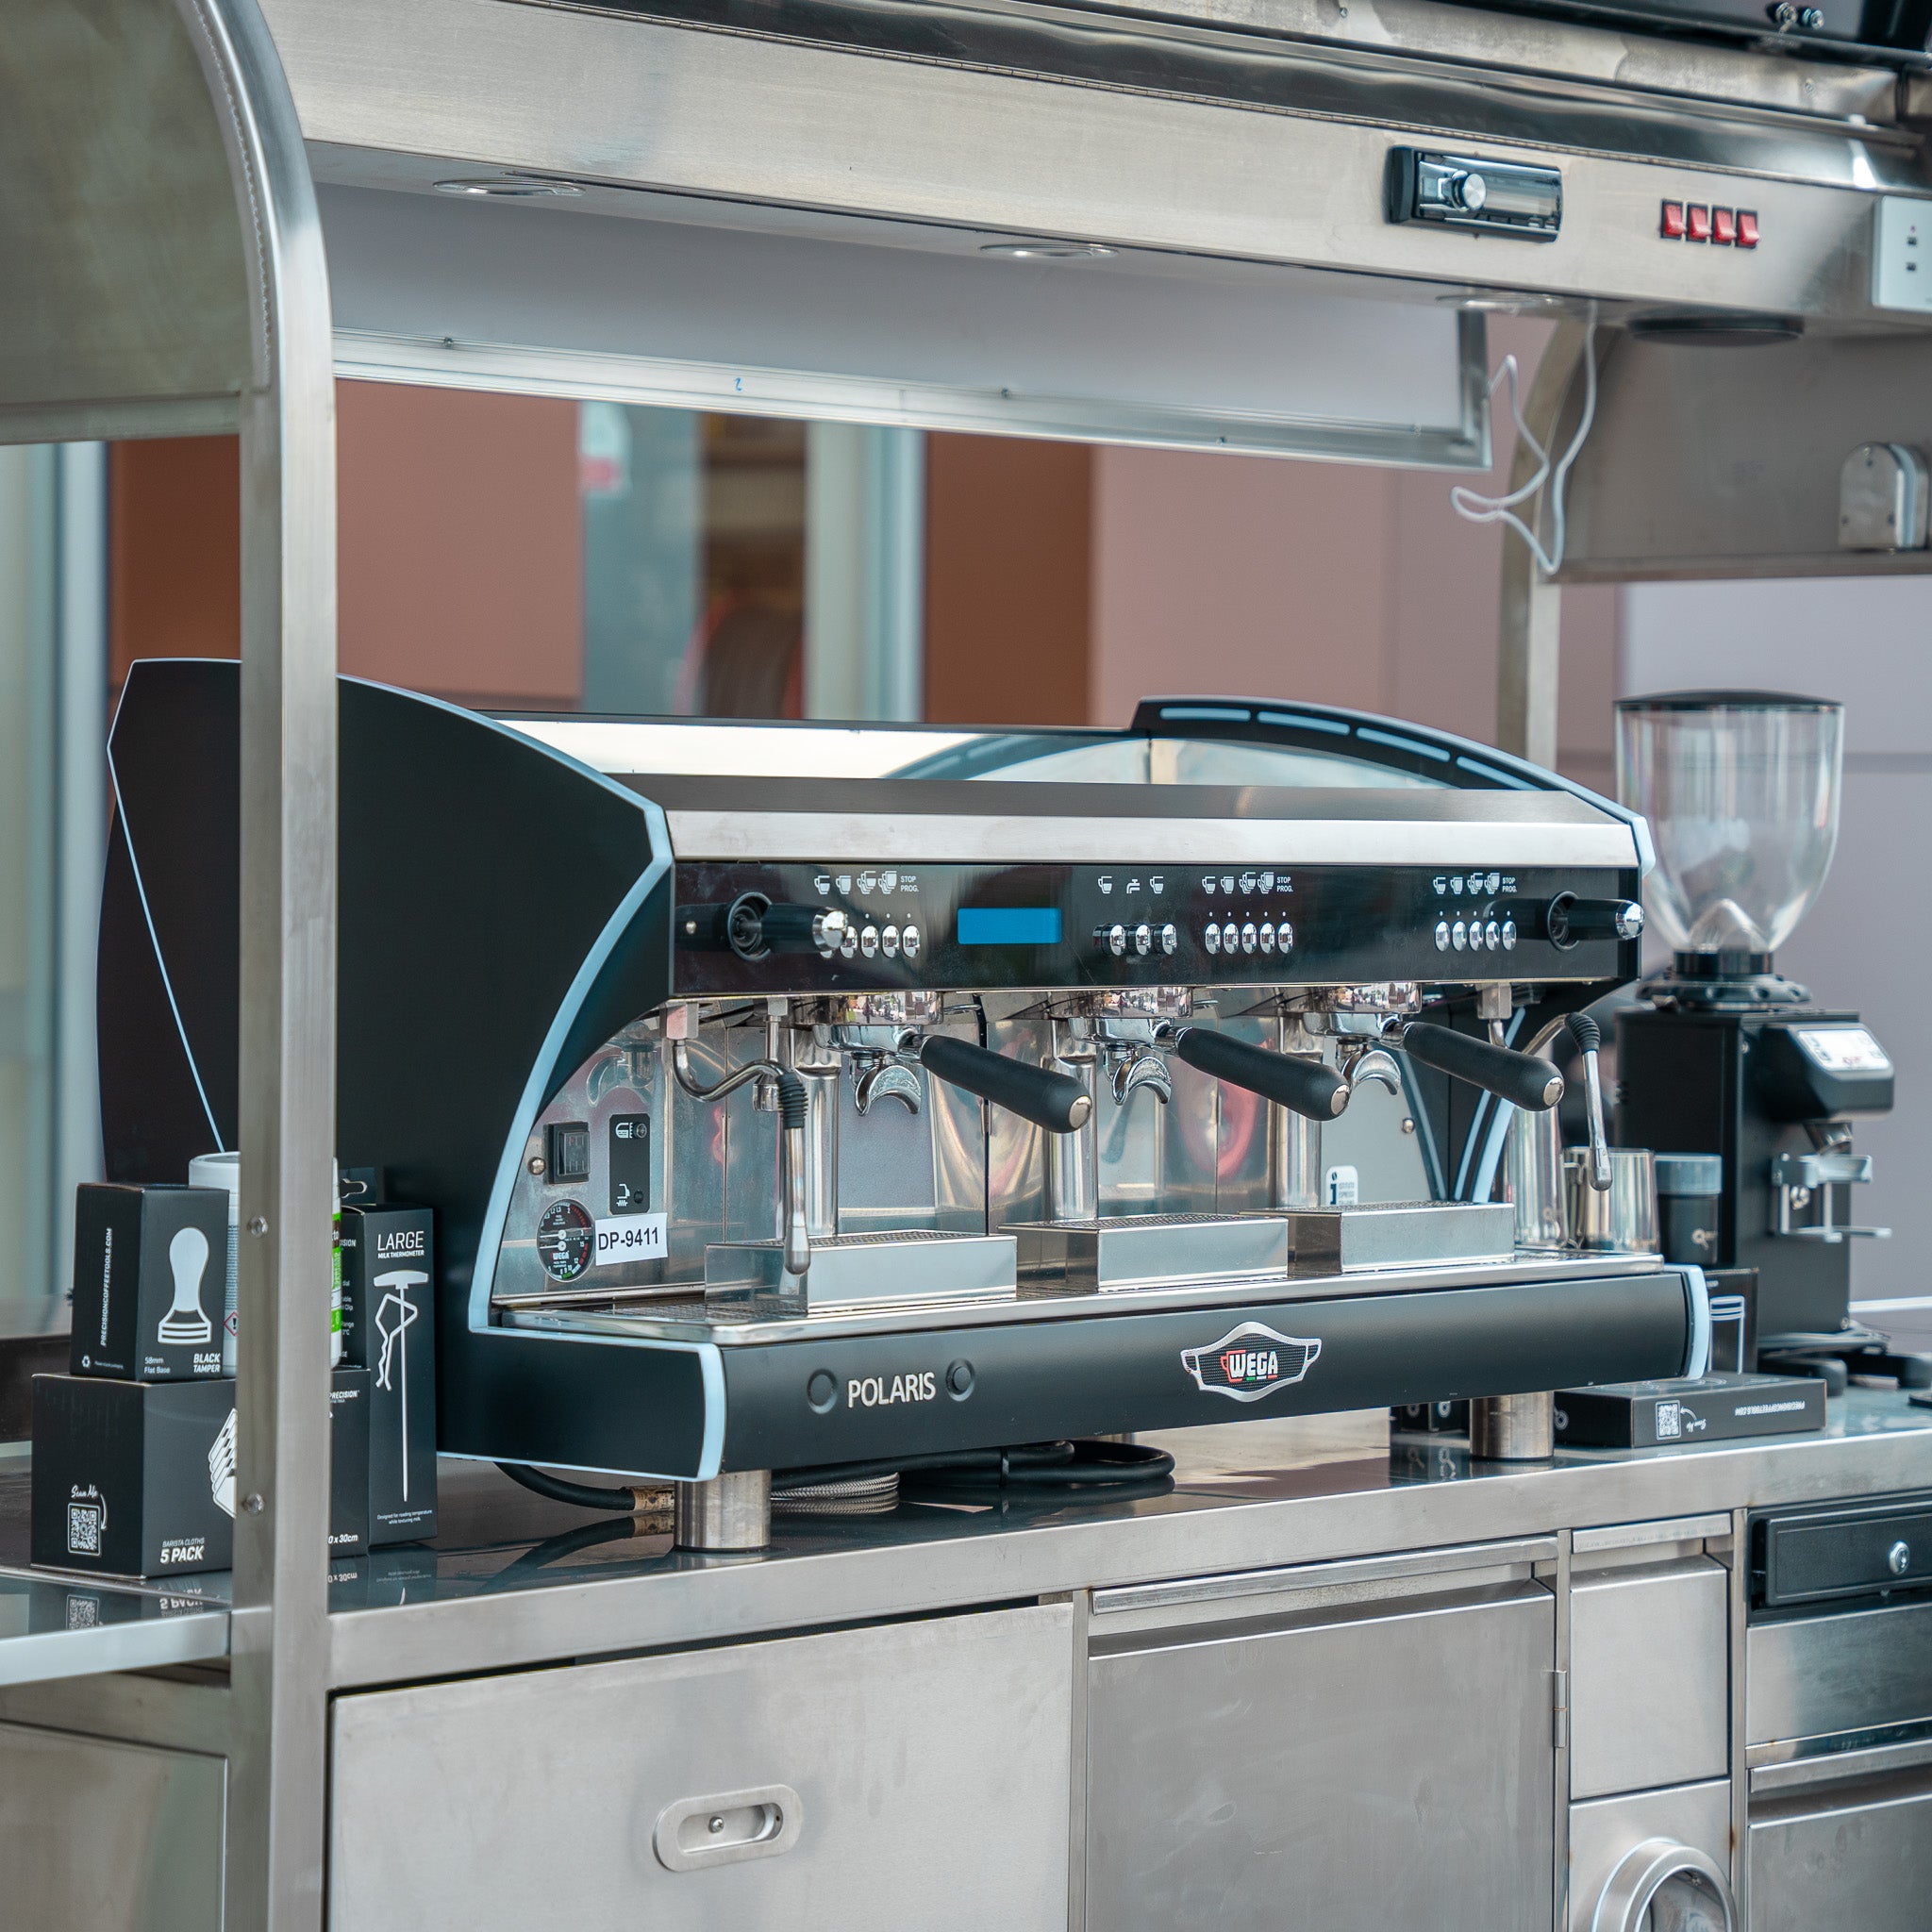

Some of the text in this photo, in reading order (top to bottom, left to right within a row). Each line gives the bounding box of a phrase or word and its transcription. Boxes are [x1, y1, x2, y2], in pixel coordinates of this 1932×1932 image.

[900, 875, 917, 884] STOP
[1276, 875, 1291, 884] STOP
[1502, 875, 1516, 884] STOP
[900, 884, 919, 892] PROG.
[1276, 884, 1293, 892] PROG.
[1502, 884, 1518, 892] PROG.
[377, 1230, 425, 1251] LARGE
[598, 1226, 658, 1251] DP-9411
[390, 1250, 425, 1258] THERMOMETER
[100, 1227, 112, 1348] PRECISIONCOFFEETOOLS.COM
[144, 1356, 163, 1365] 58mm
[193, 1353, 221, 1364] BLACK
[193, 1364, 220, 1374] TAMPER
[1228, 1350, 1278, 1378] WEGA
[848, 1371, 936, 1408] POLARIS
[71, 1484, 99, 1499] Scan Me
[162, 1537, 205, 1548] BARISTA CLOTHS
[340, 1533, 358, 1543] 30cm
[159, 1545, 205, 1564] 5 PACK
